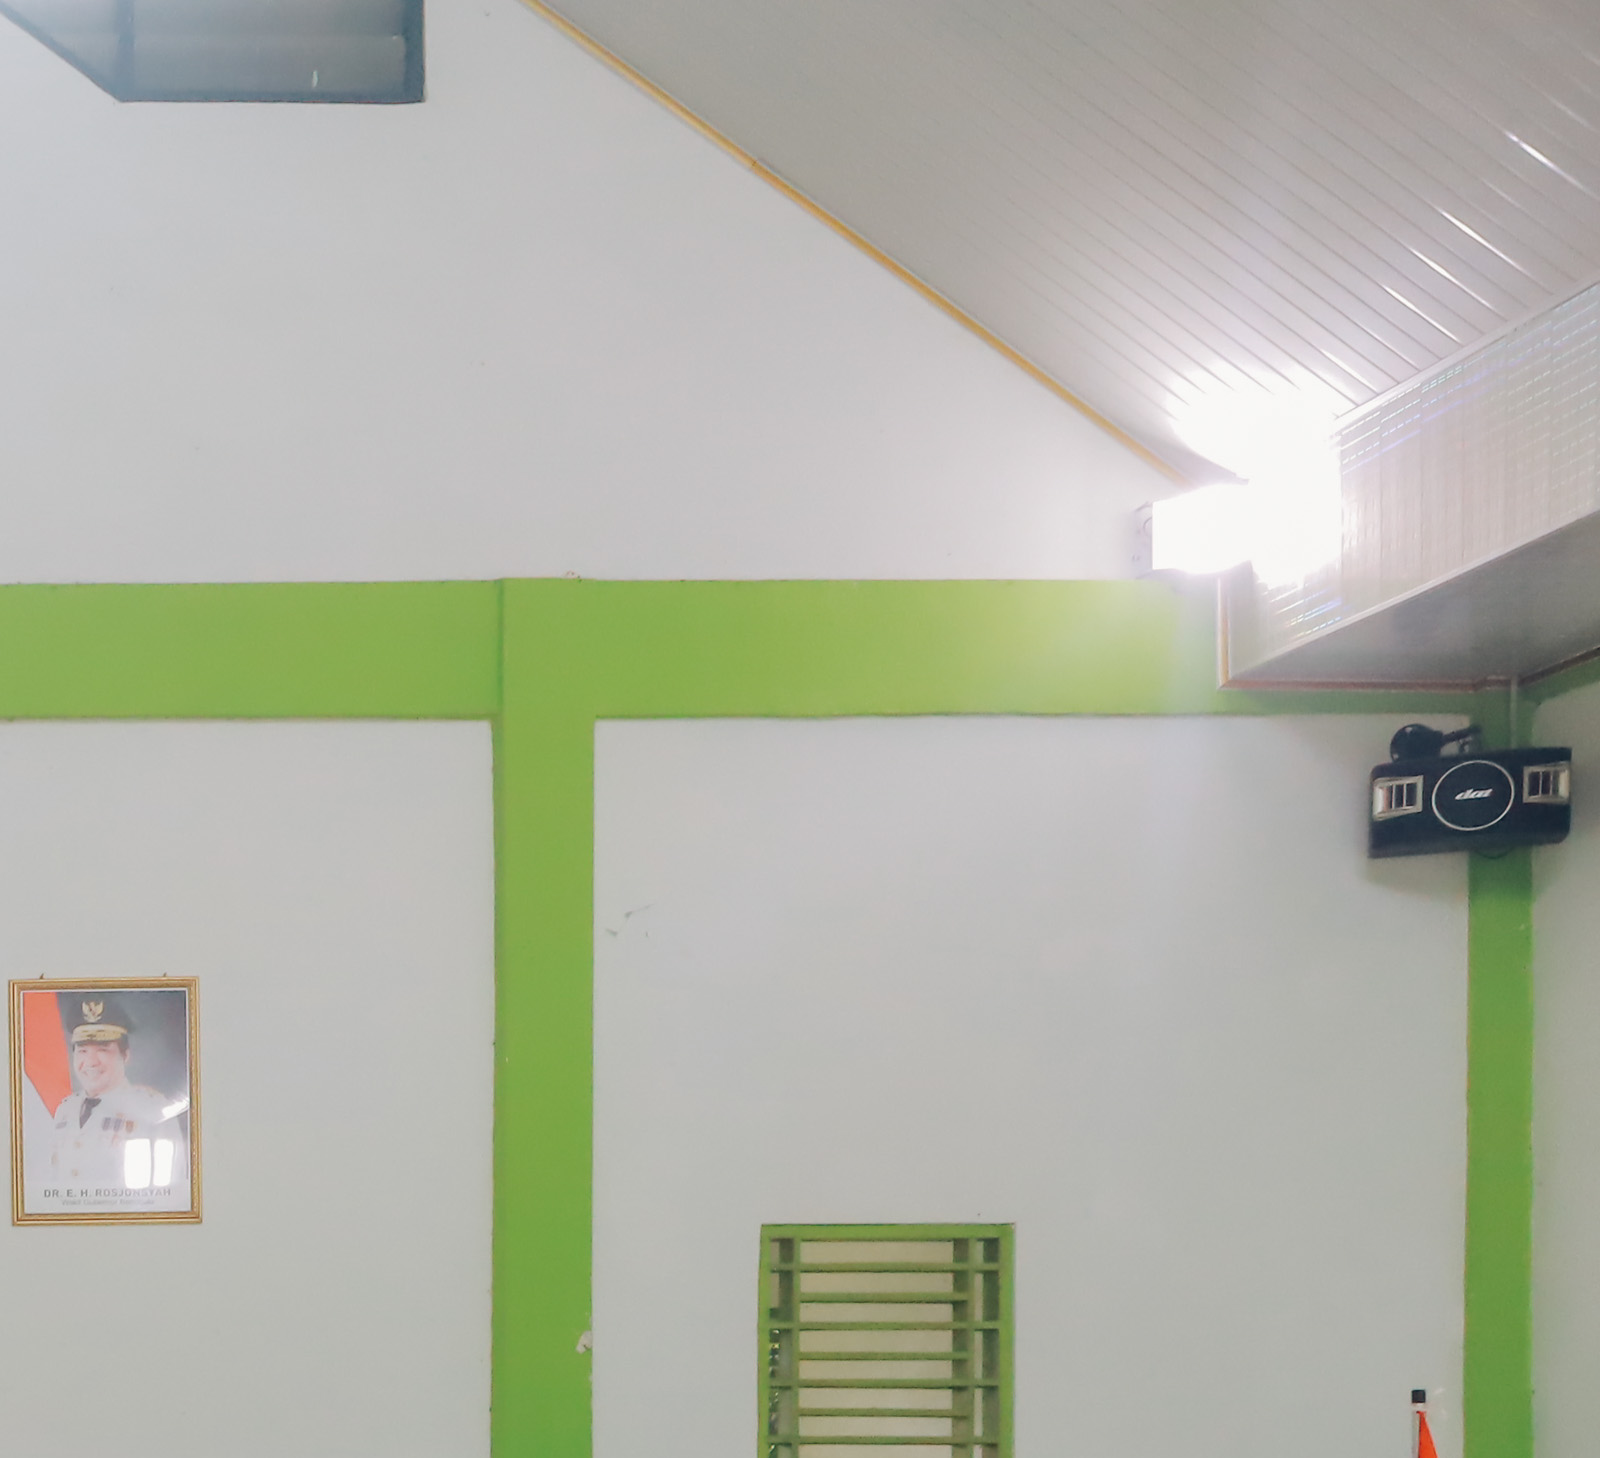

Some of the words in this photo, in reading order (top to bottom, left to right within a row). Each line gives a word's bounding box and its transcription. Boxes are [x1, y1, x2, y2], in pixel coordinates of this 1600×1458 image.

[43, 1189, 63, 1198] DR.
[66, 1189, 77, 1198] E.
[95, 1188, 171, 1197] ROSJONSYAH
